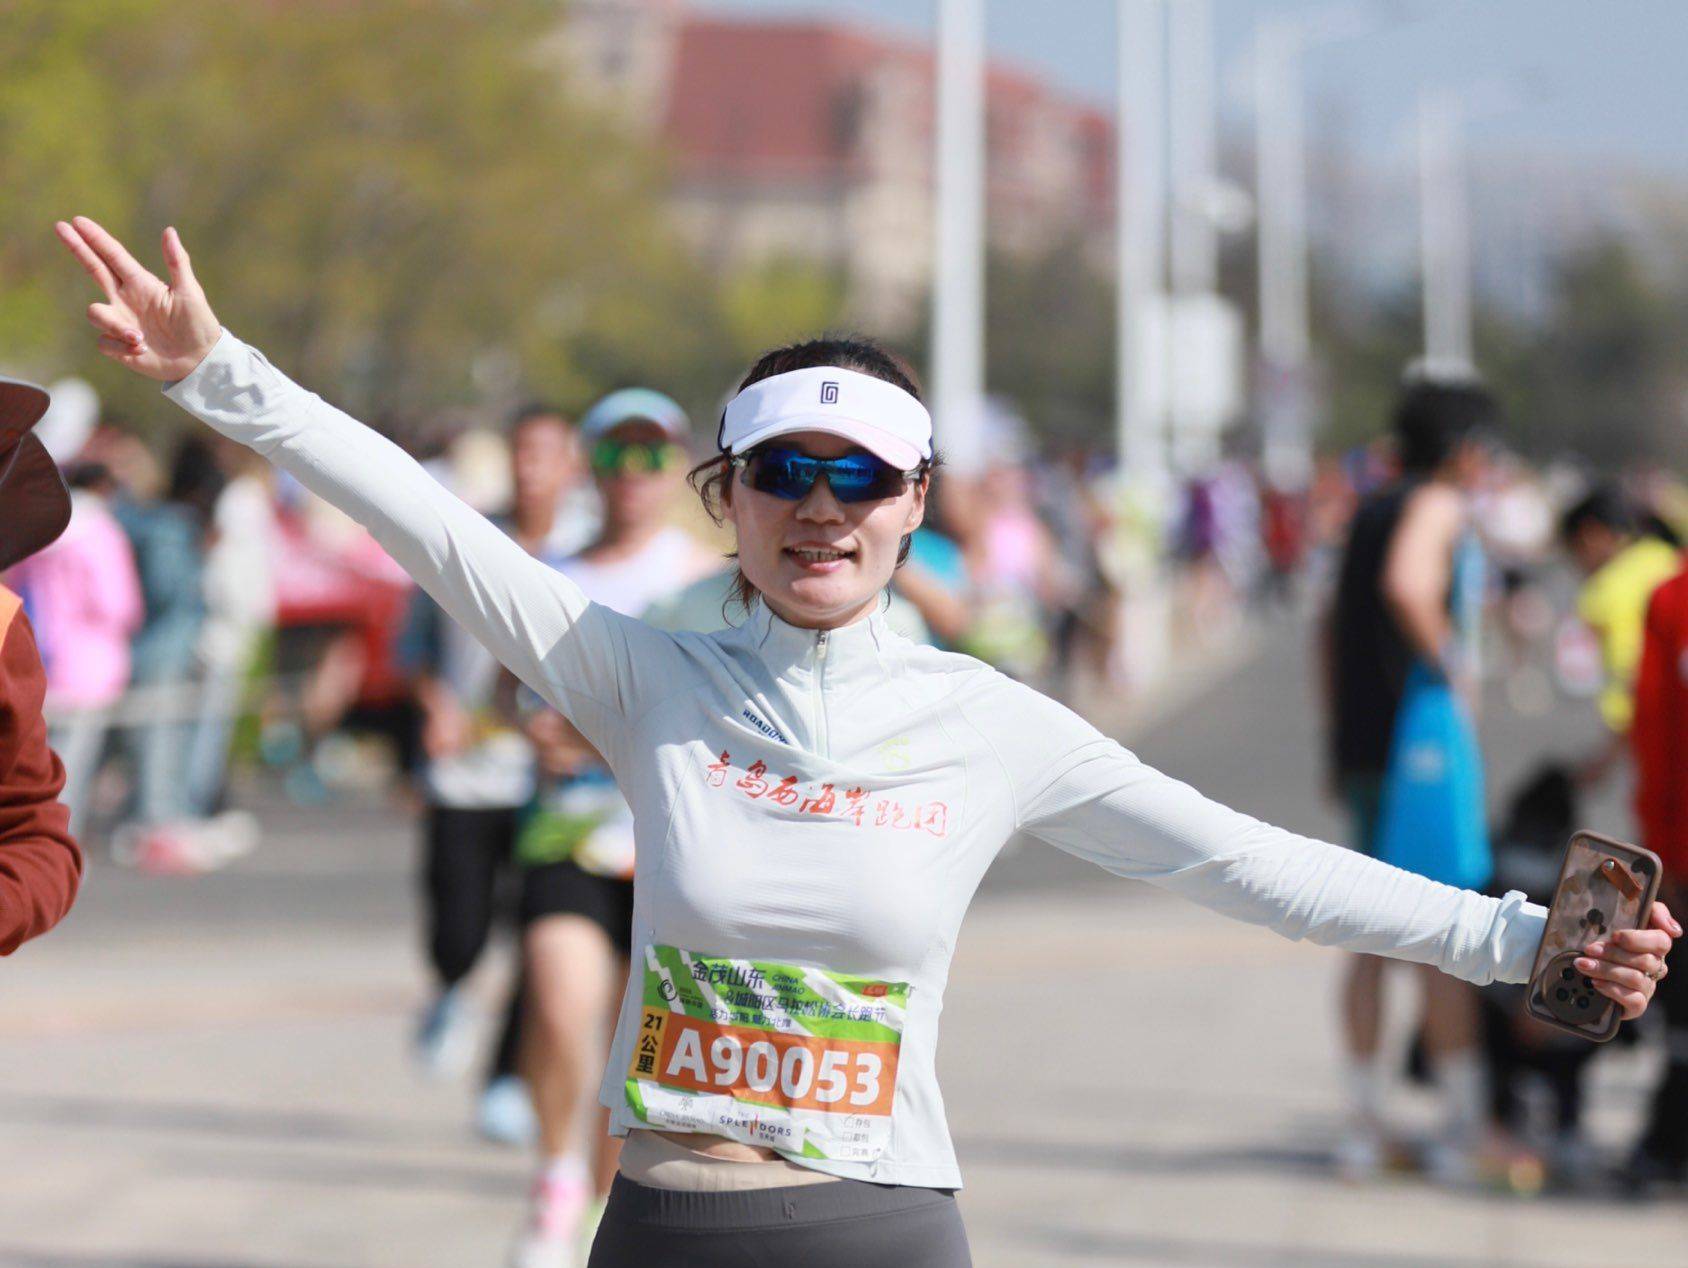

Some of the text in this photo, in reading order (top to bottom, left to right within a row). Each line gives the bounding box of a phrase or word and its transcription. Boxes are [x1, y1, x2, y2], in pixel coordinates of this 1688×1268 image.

[706, 751, 948, 838] 青岛西海岸跑团
[691, 961, 767, 988] 金茂山东
[666, 1028, 882, 1107] A90053
